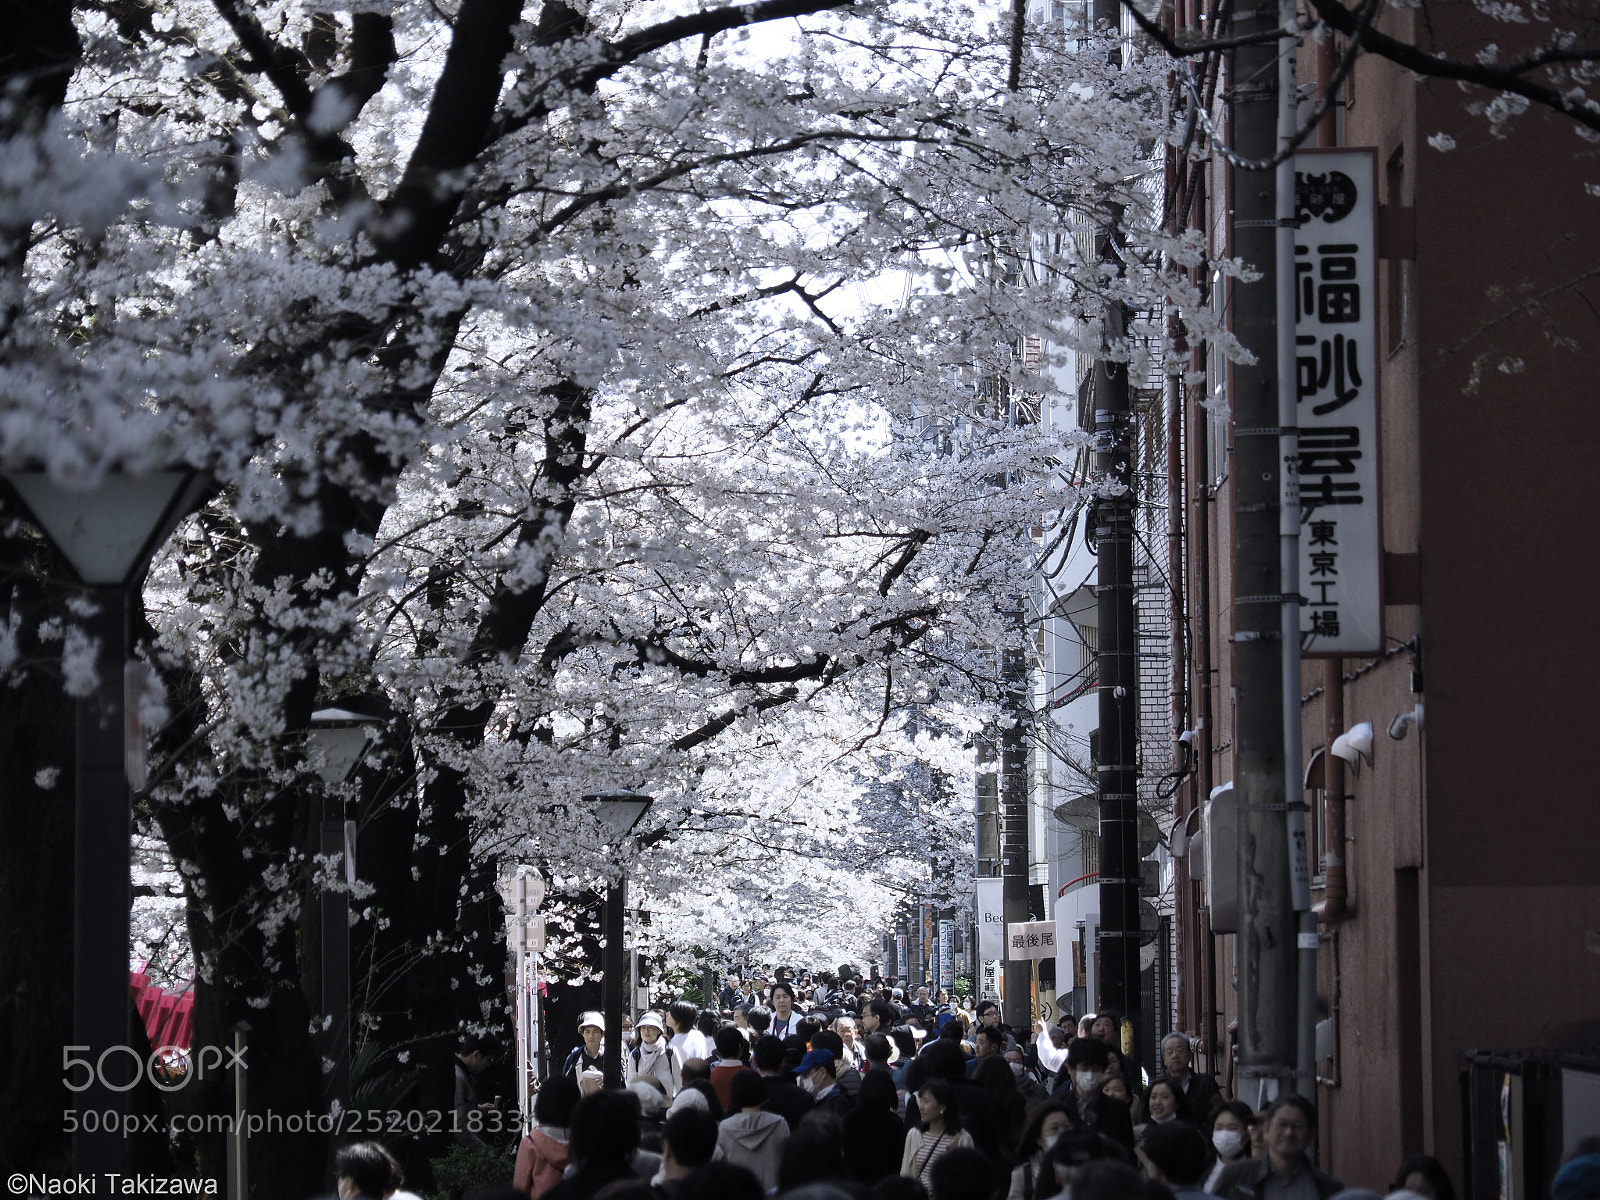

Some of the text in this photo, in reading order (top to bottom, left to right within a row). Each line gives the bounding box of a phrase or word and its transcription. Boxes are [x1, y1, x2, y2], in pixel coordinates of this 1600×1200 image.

[1308, 520, 1340, 638] 東京工場
[1011, 932, 1054, 949] 最後尾
